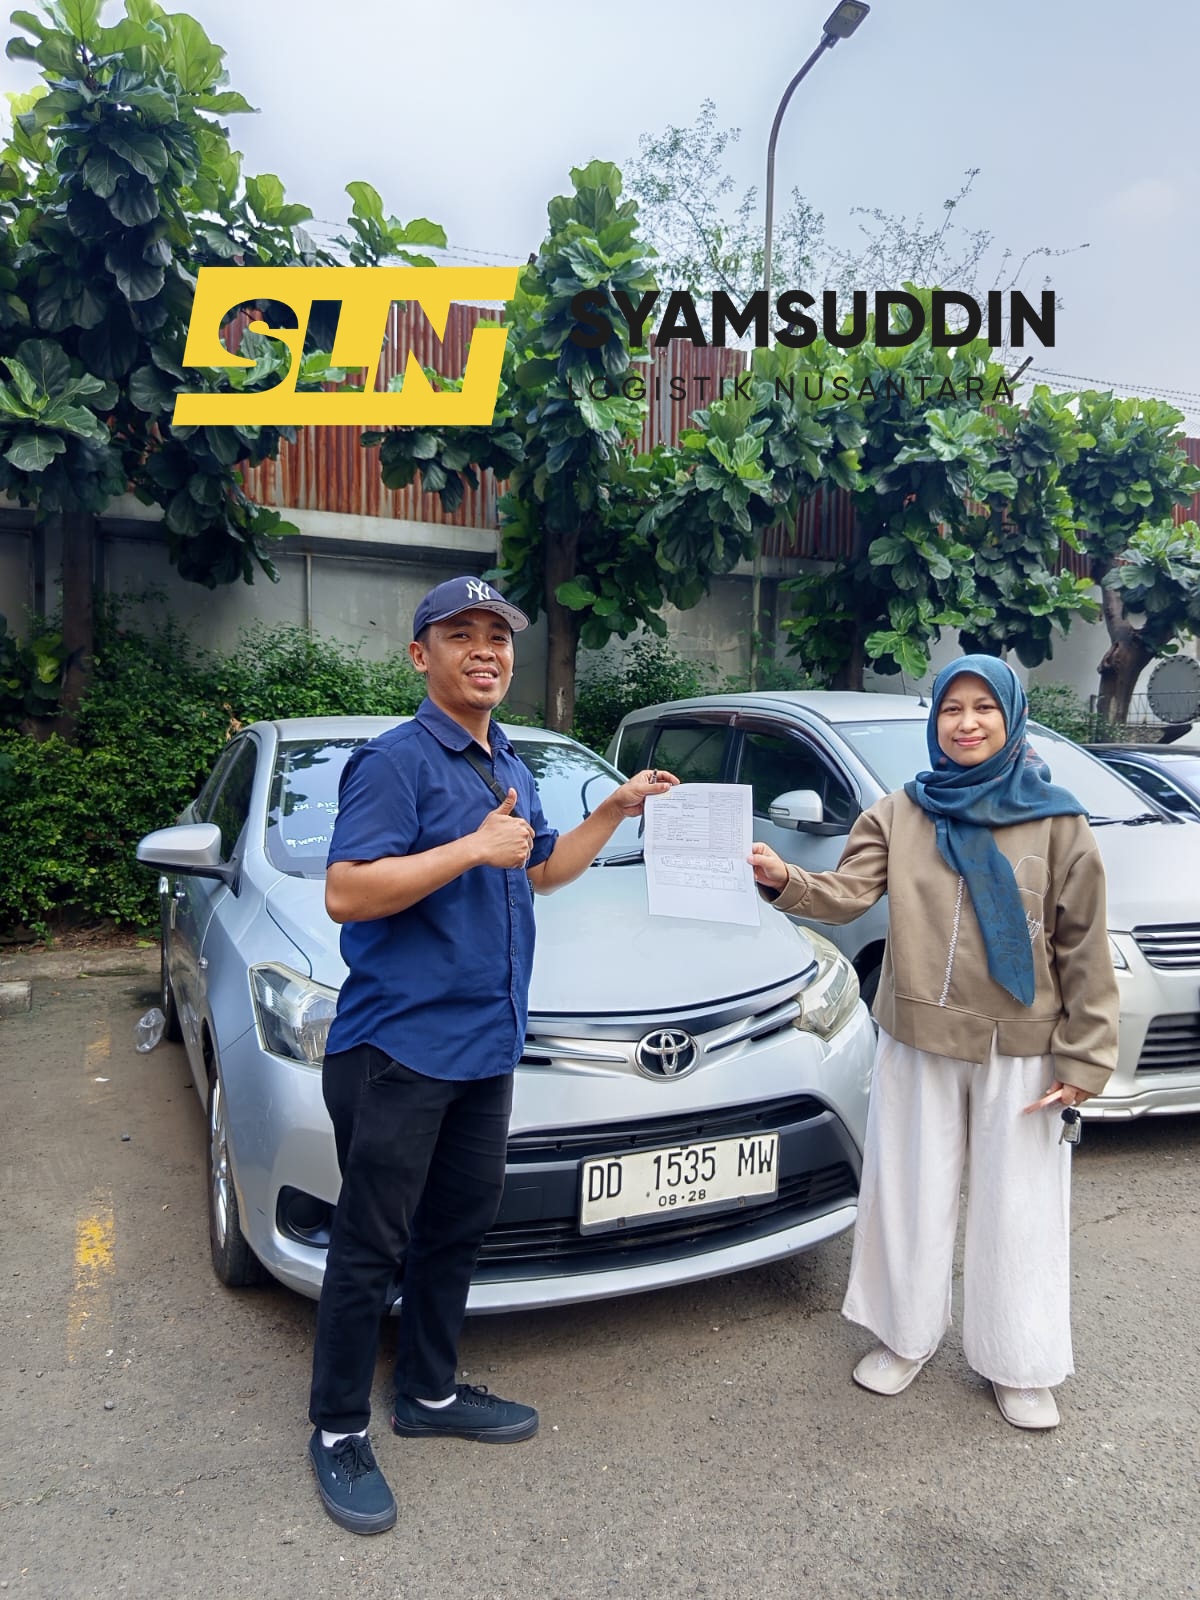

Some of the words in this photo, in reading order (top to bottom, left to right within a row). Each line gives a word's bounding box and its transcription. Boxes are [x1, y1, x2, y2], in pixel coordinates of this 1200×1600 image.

[465, 580, 491, 601] NY
[588, 1162, 623, 1202] DD
[652, 1146, 717, 1191] 1535
[737, 1138, 776, 1177] MW
